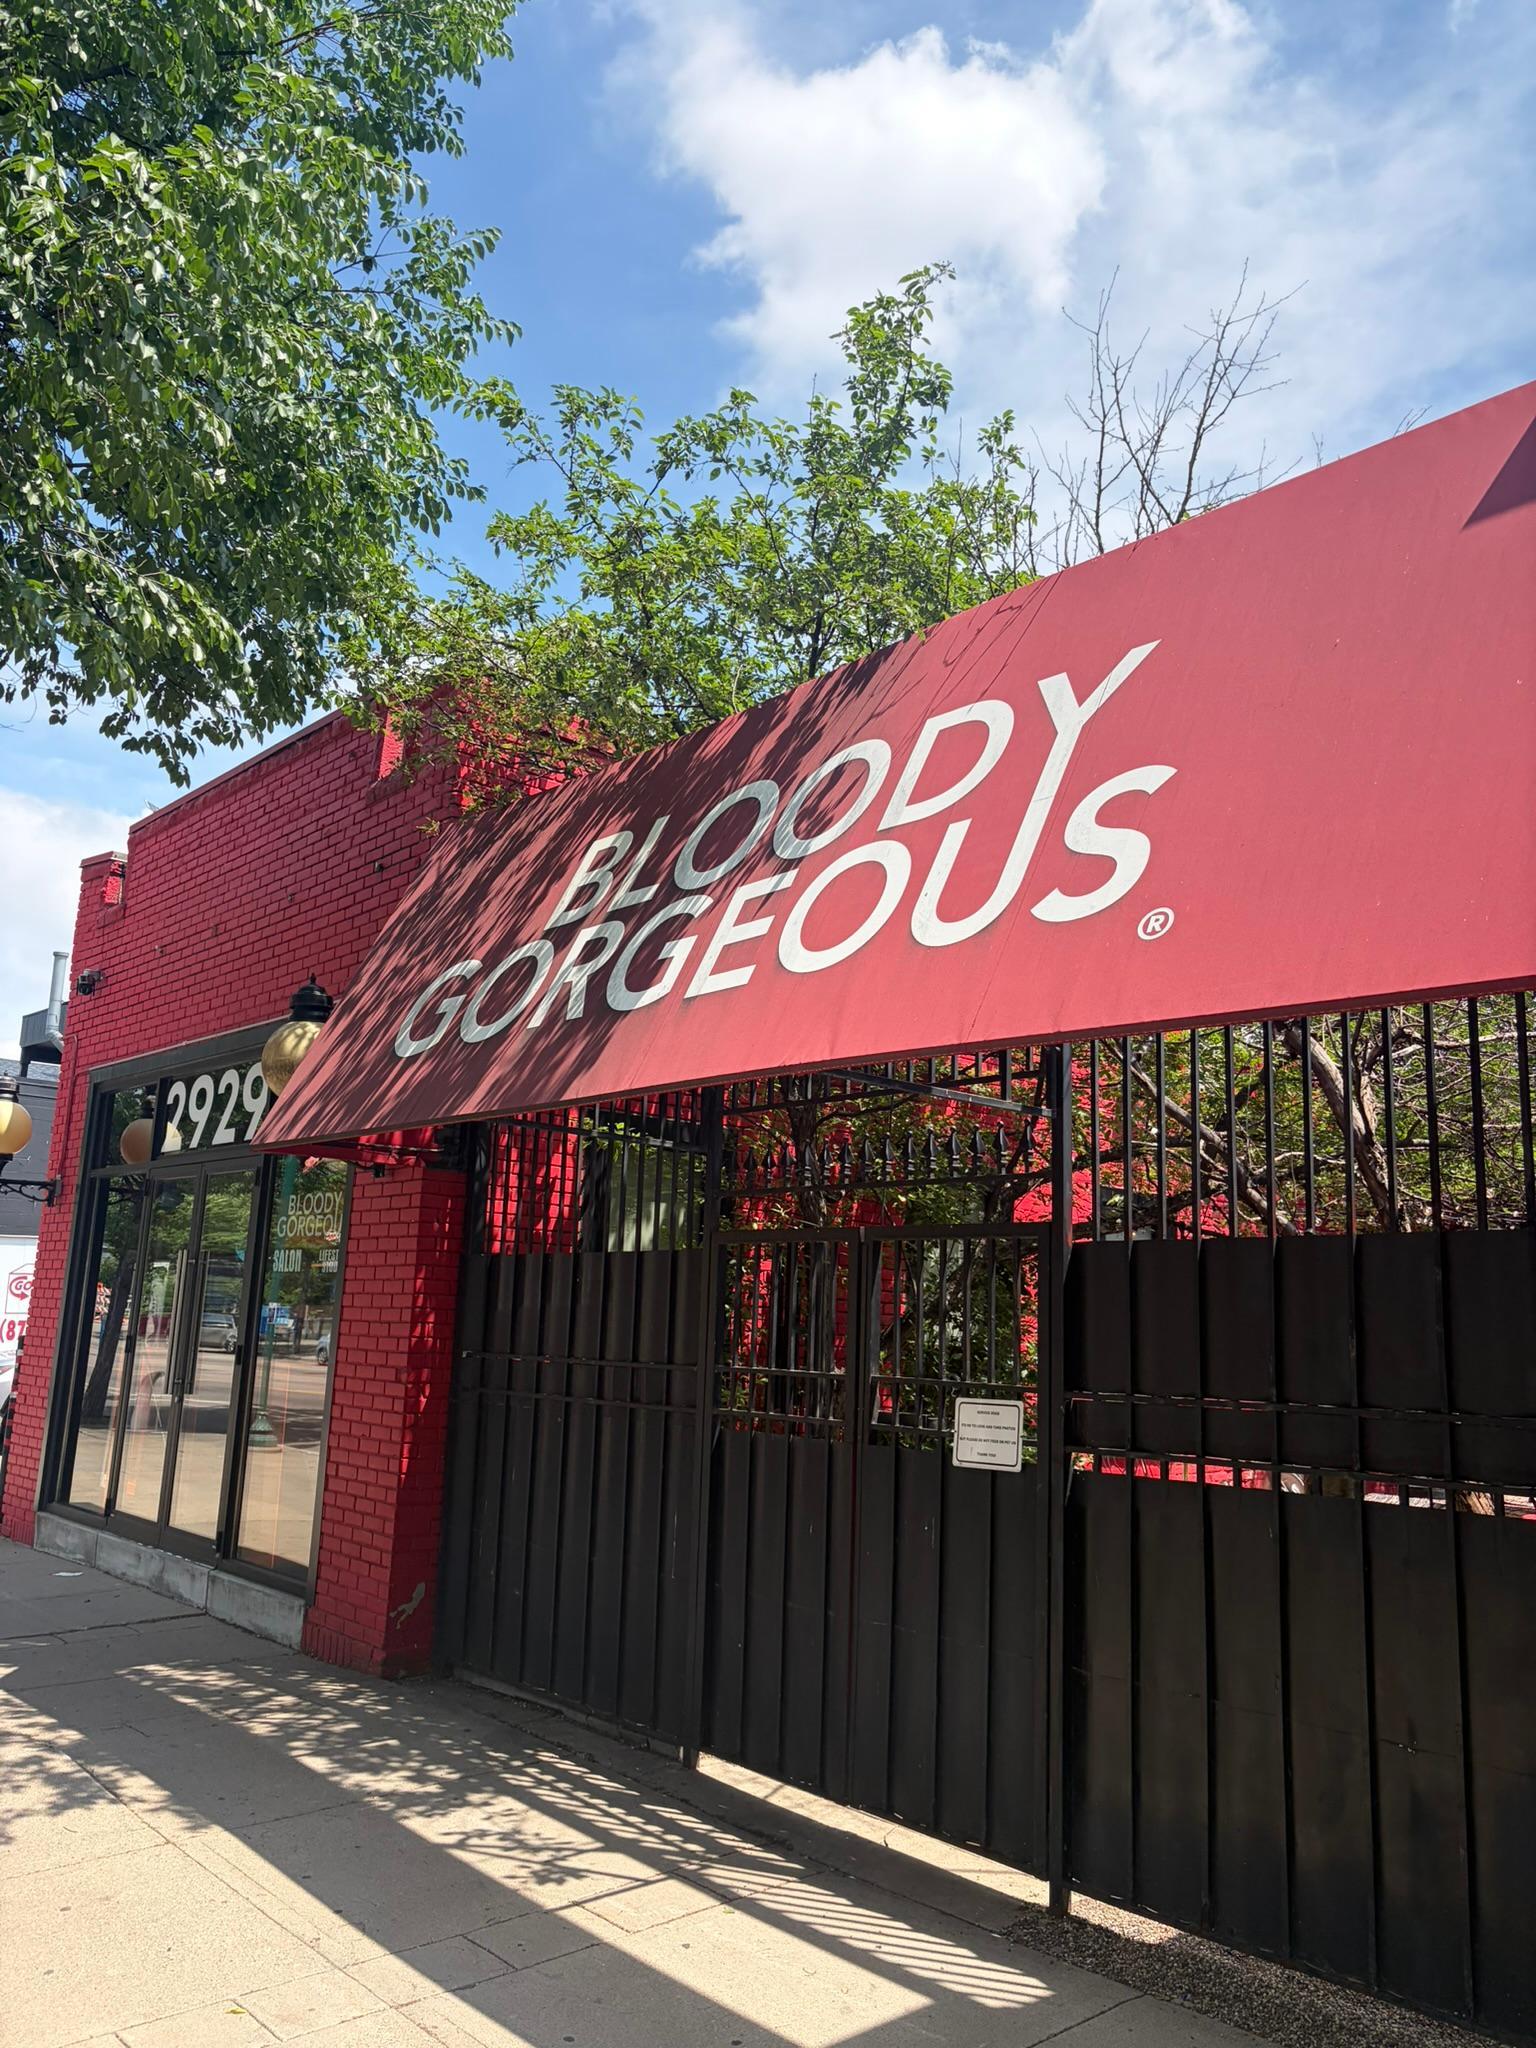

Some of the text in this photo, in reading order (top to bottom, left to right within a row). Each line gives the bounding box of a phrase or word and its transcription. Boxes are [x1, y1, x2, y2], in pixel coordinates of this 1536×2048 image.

[545, 640, 1161, 931] BLOODY
[394, 764, 1178, 1058] GORGEOUS
[160, 1062, 269, 1153] 2929
[288, 1191, 343, 1216] BLOODY
[272, 1249, 303, 1273] SALON
